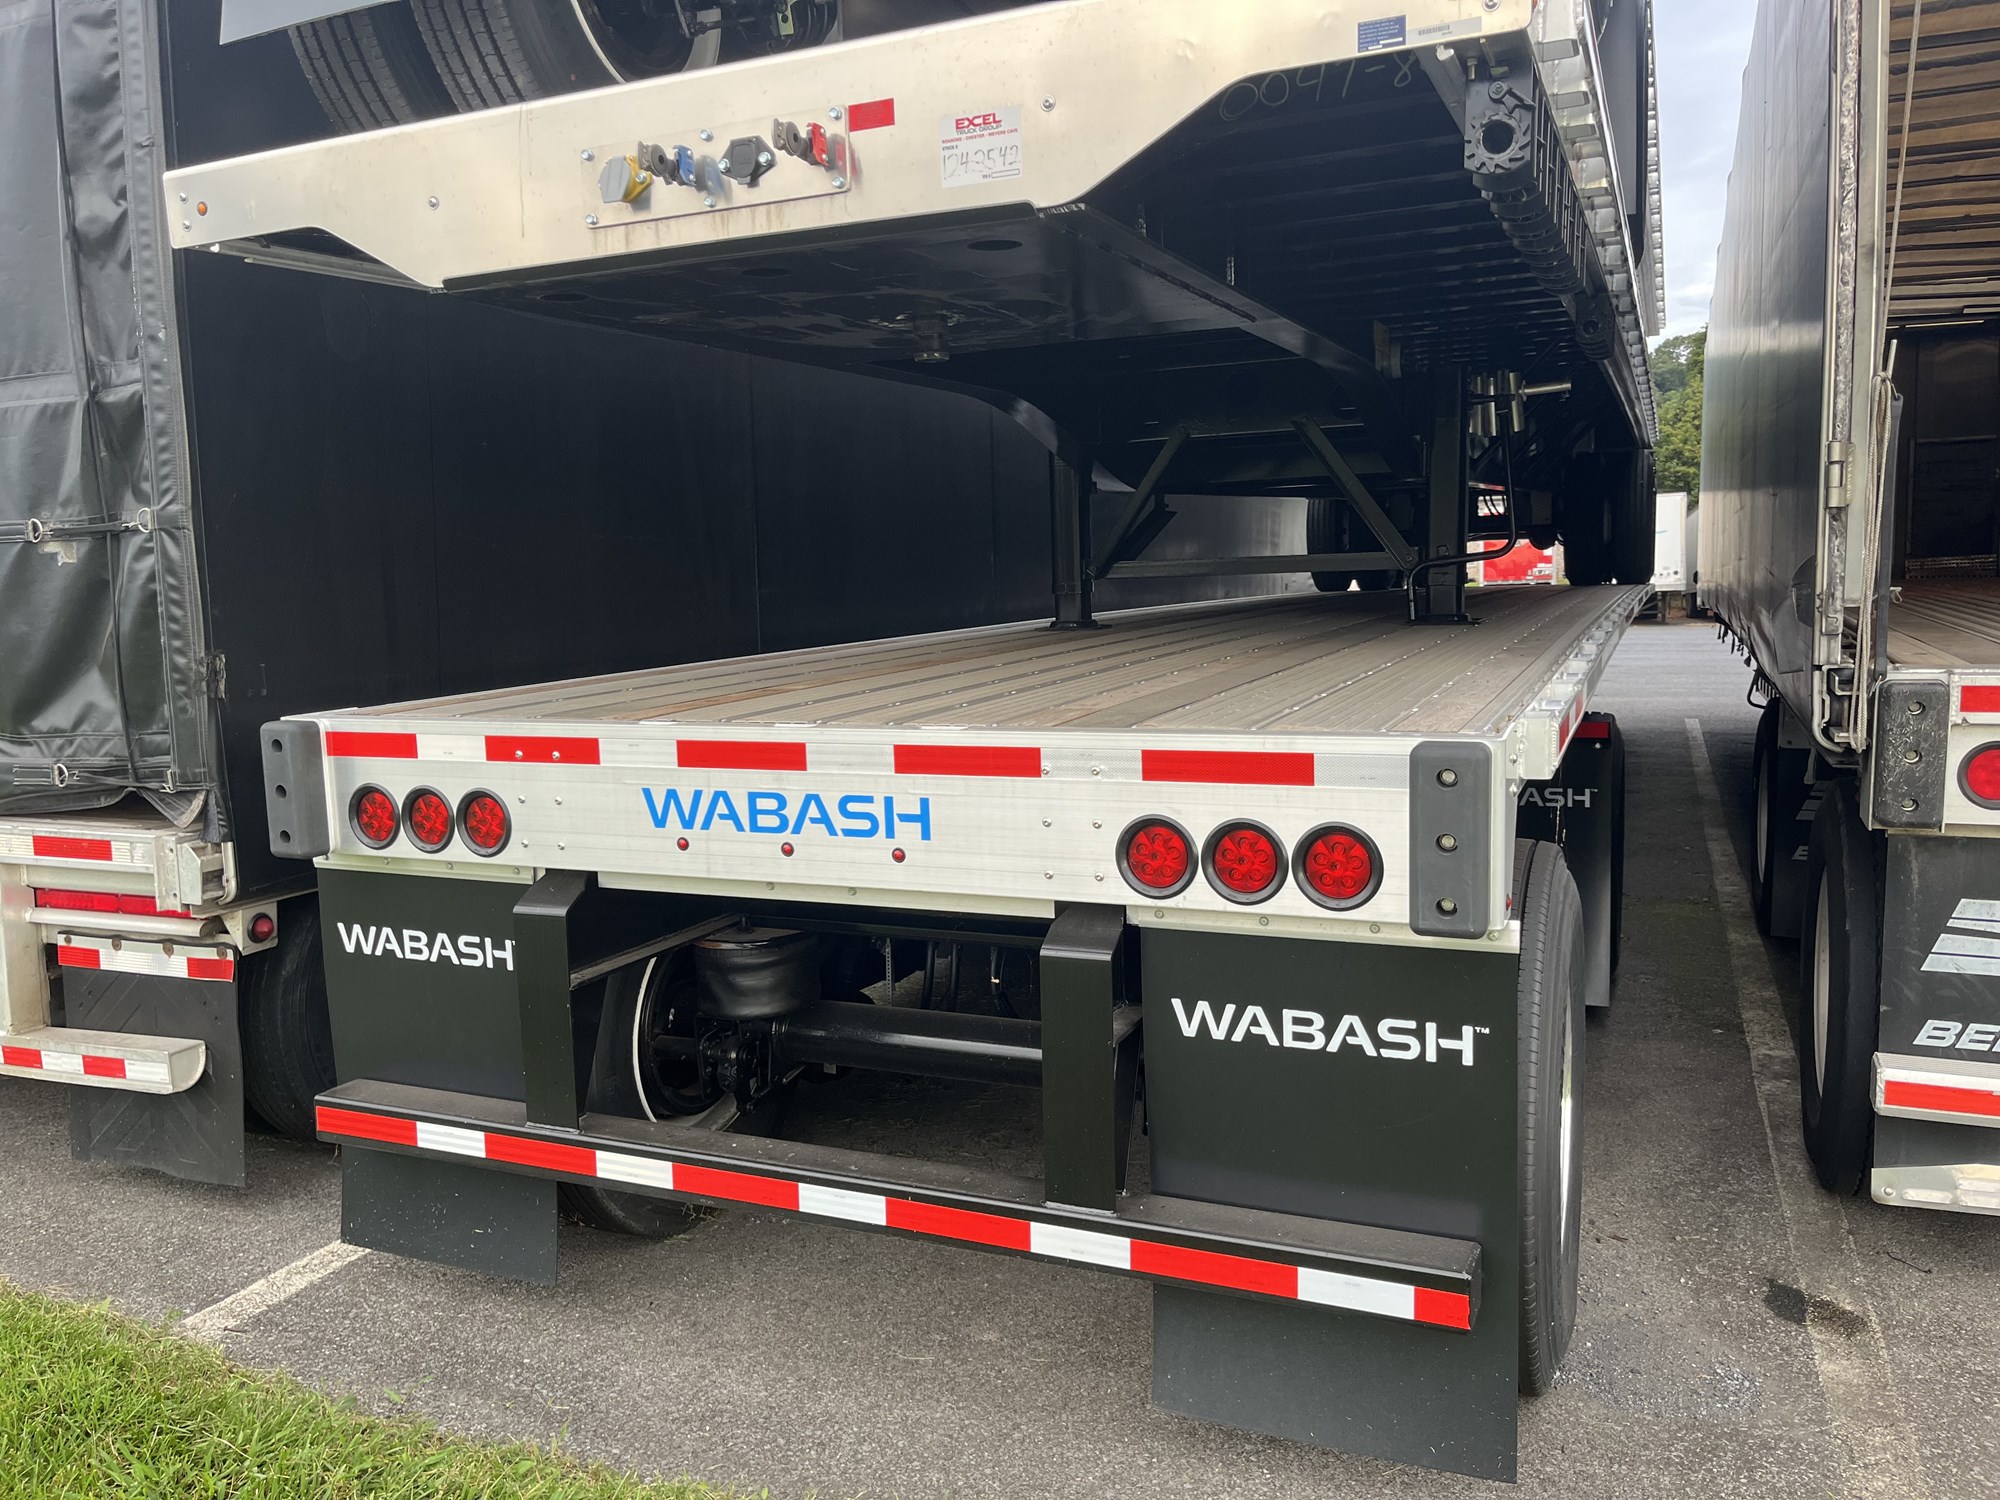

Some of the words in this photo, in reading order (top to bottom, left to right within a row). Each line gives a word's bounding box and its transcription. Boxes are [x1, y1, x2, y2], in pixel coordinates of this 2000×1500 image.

[955, 112, 1002, 130] EXCEL
[956, 127, 977, 136] TRUCK
[978, 124, 1002, 133] GROUP
[641, 787, 931, 841] WABASH
[1912, 1019, 2000, 1053] BE
